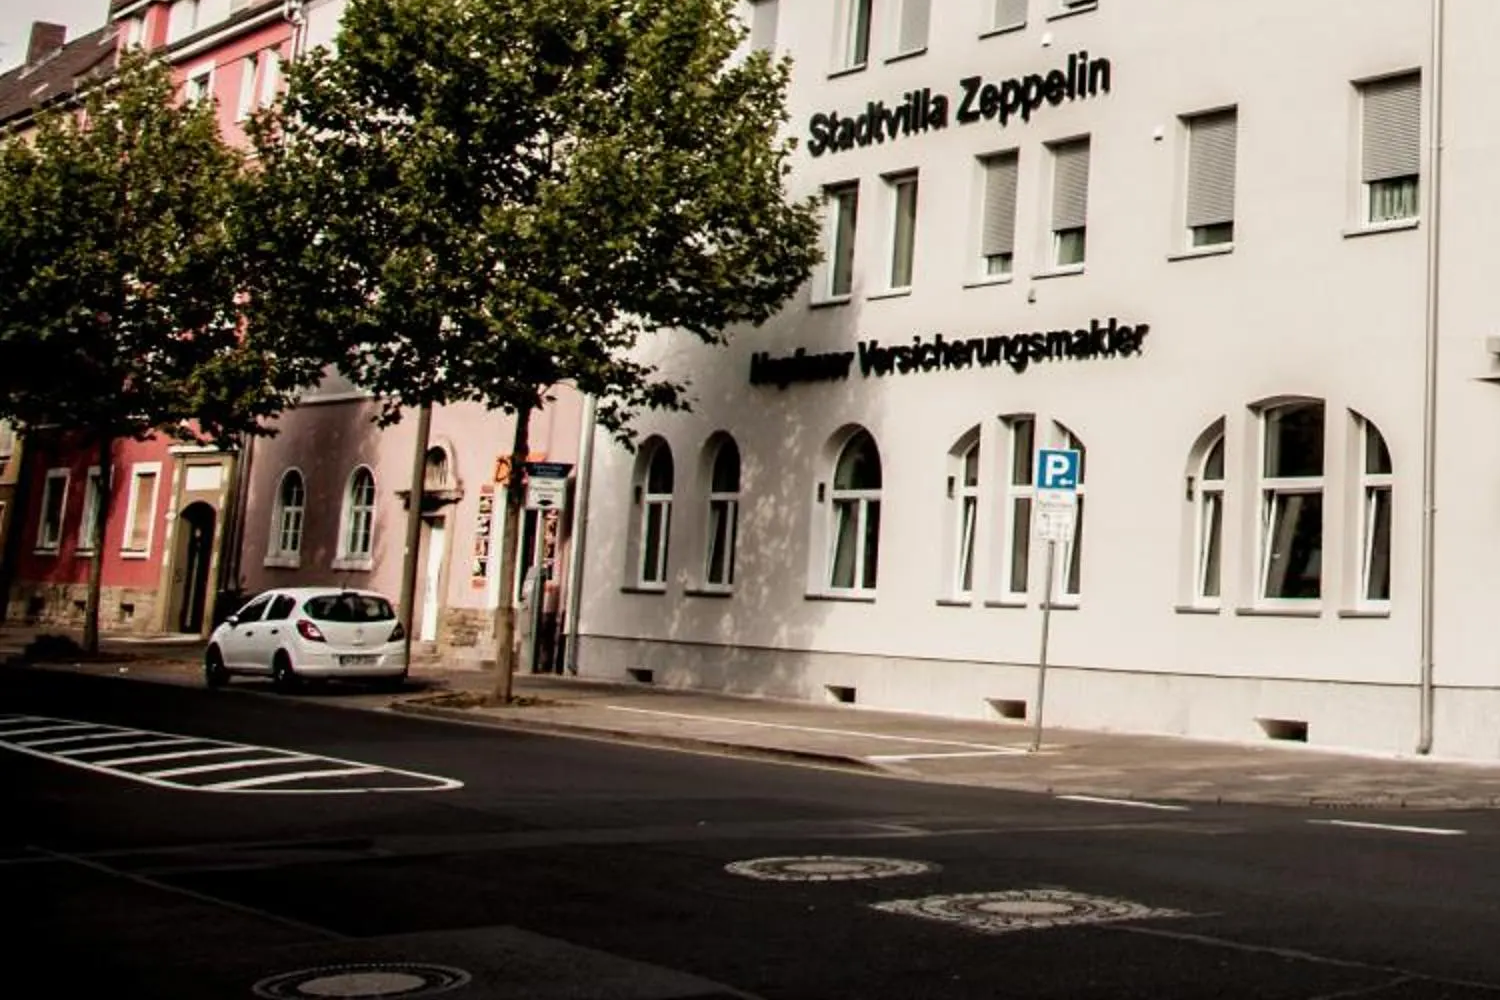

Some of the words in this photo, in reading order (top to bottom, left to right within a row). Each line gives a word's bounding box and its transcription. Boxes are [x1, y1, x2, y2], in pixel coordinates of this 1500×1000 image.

[807, 87, 948, 158] Stadtvilla
[956, 50, 1112, 126] Zeppelin
[857, 316, 1149, 377] Versicherungsmakler
[1045, 454, 1070, 486] P
